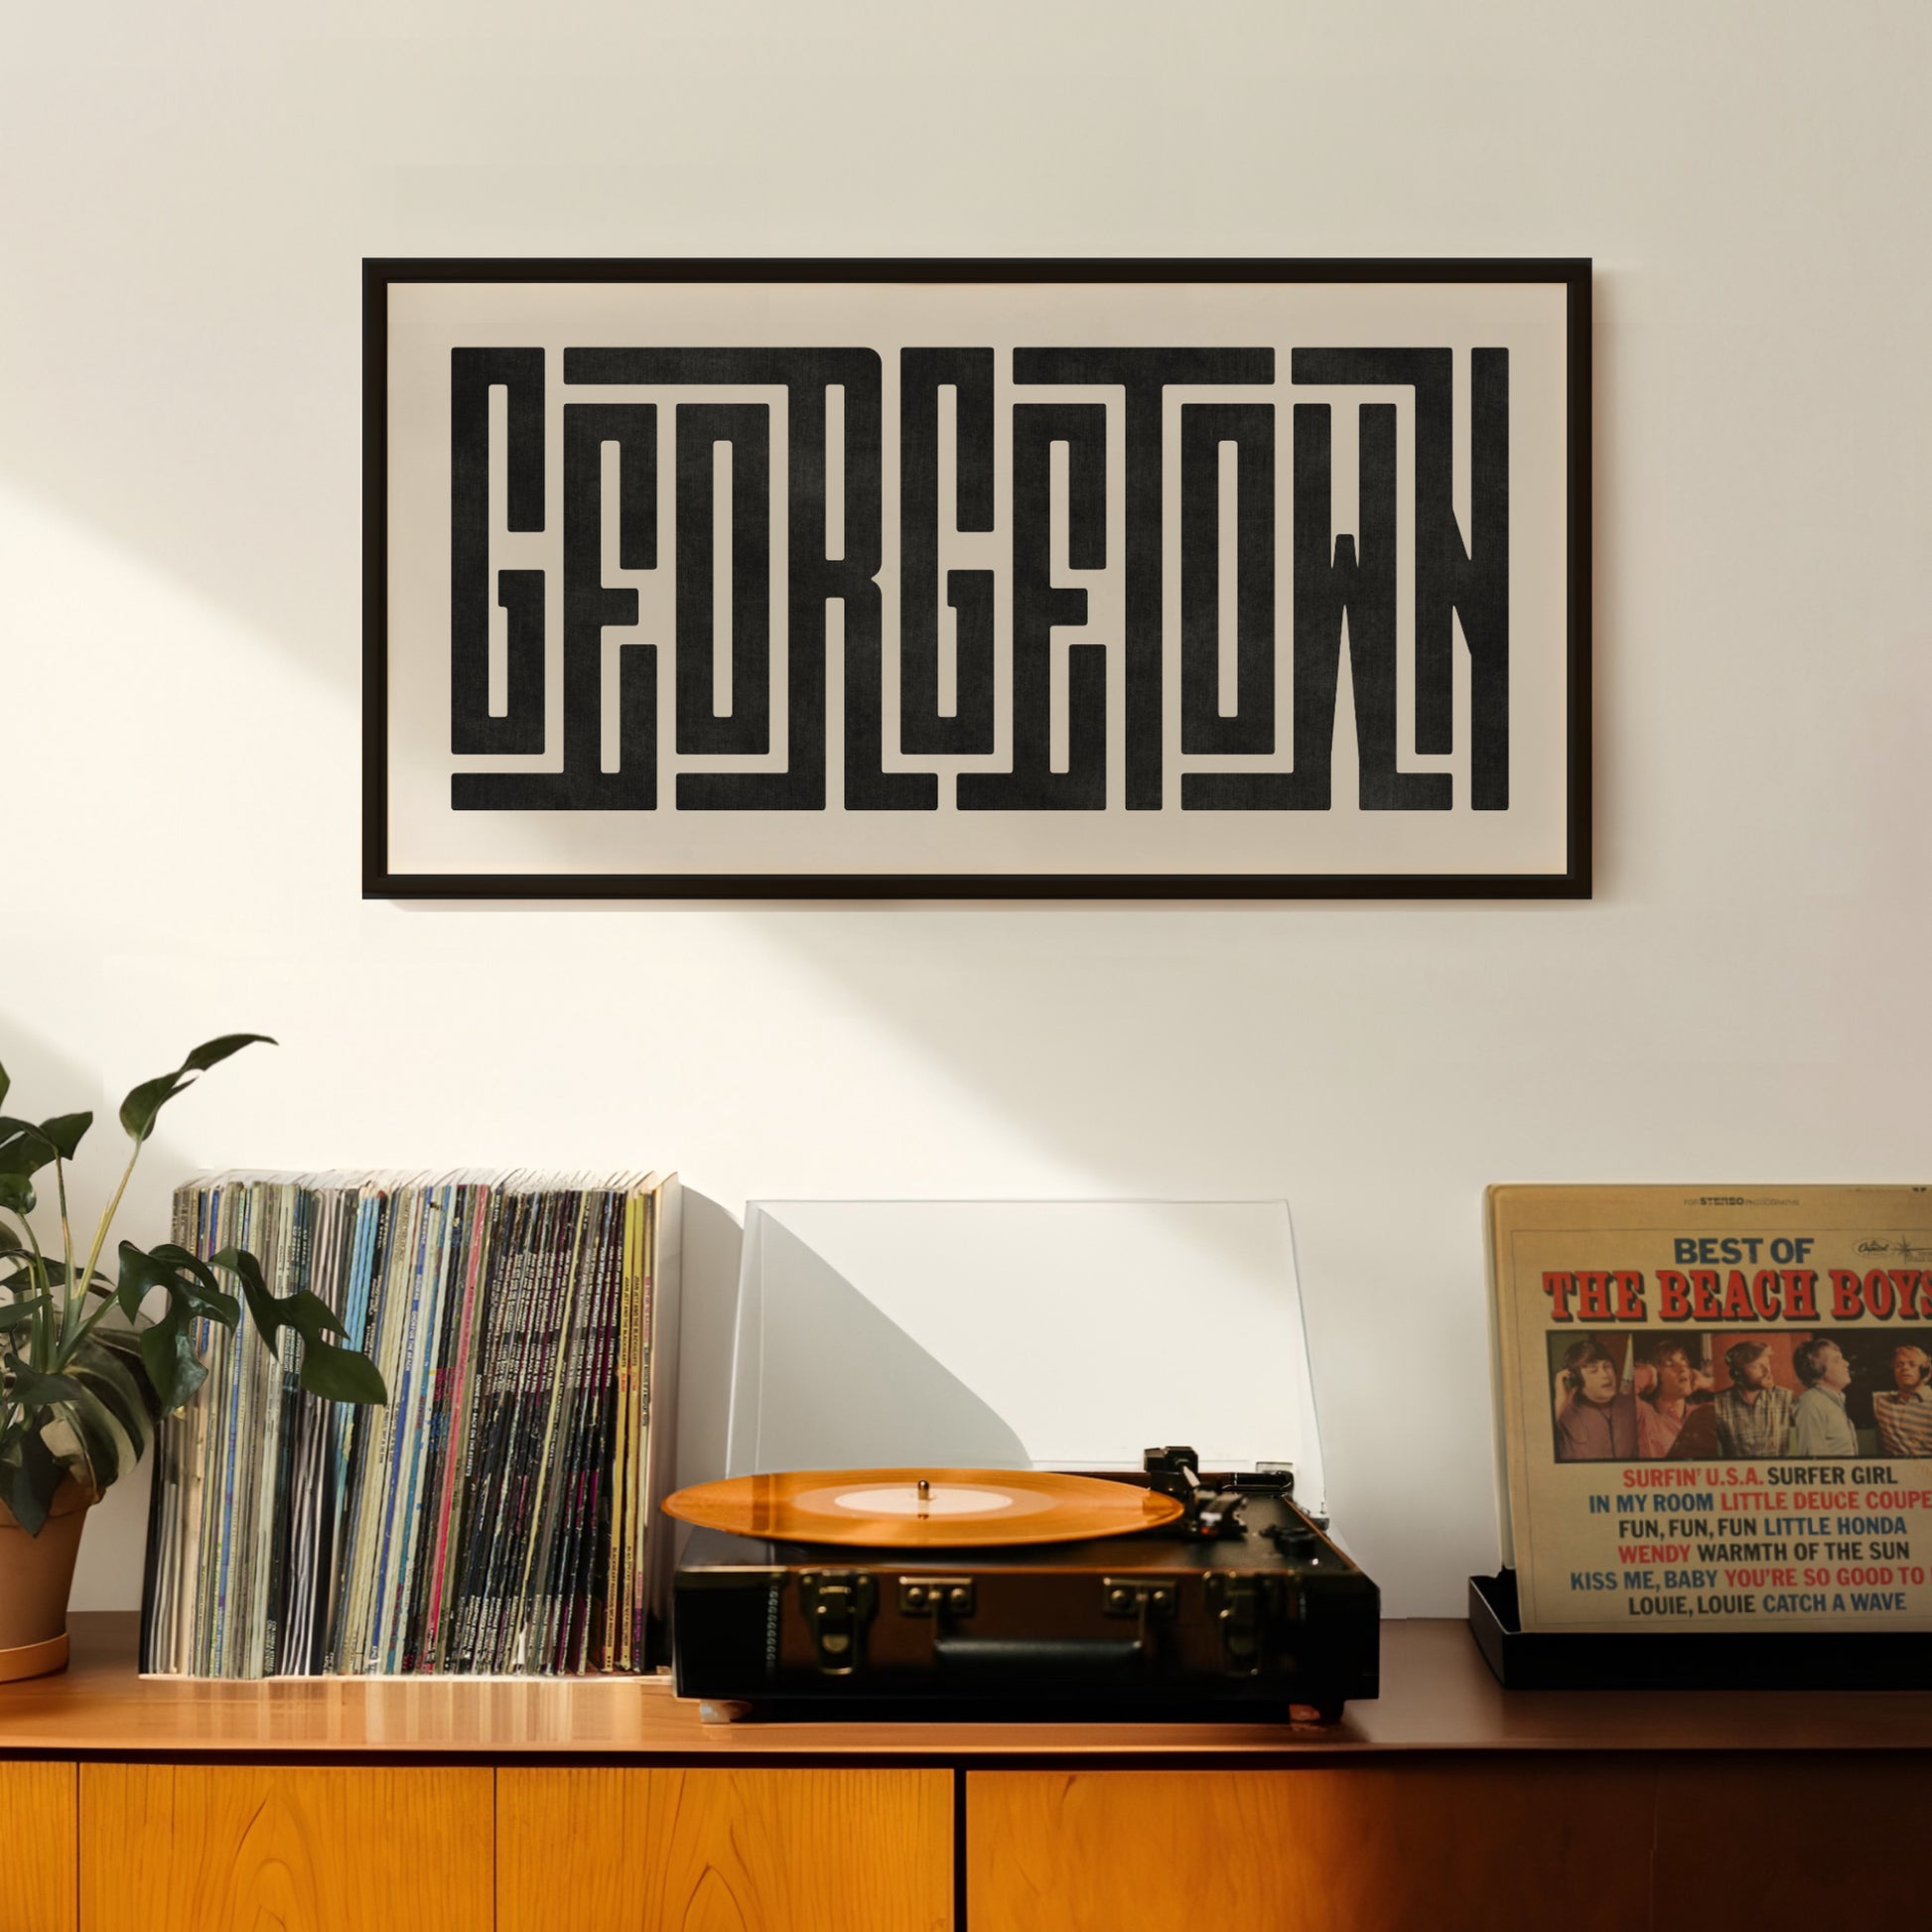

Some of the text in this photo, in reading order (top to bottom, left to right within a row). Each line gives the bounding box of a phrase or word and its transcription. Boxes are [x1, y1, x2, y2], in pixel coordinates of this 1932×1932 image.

[451, 347, 1509, 810] GEORGETOWN
[1700, 1196, 1744, 1206] STEREO
[1675, 1238, 1814, 1264] BEST OF
[1543, 1271, 1647, 1322] THE
[1656, 1269, 1821, 1322] BEACH
[1623, 1466, 1898, 1488] SURFIN' U.S.A. SURFER GIRL
[1589, 1490, 1932, 1513] IN MY ROOM LITTLE DEUCE COUPE
[1619, 1517, 1906, 1541] FUN, FUN, FUN LITTLE HONDA
[1618, 1542, 1909, 1564] WENDY WARMTH OF THE SUN
[1571, 1572, 1617, 1590] KISS
[1624, 1571, 1660, 1591] ME,
[1665, 1570, 1718, 1588] BABY
[1725, 1569, 1797, 1587] YOU'RE
[1804, 1568, 1830, 1587] SO
[1837, 1568, 1893, 1586] GOOD
[1898, 1567, 1924, 1585] TO
[1629, 1592, 1906, 1617] LOUIE, LOUIE CATCH A WAVE
